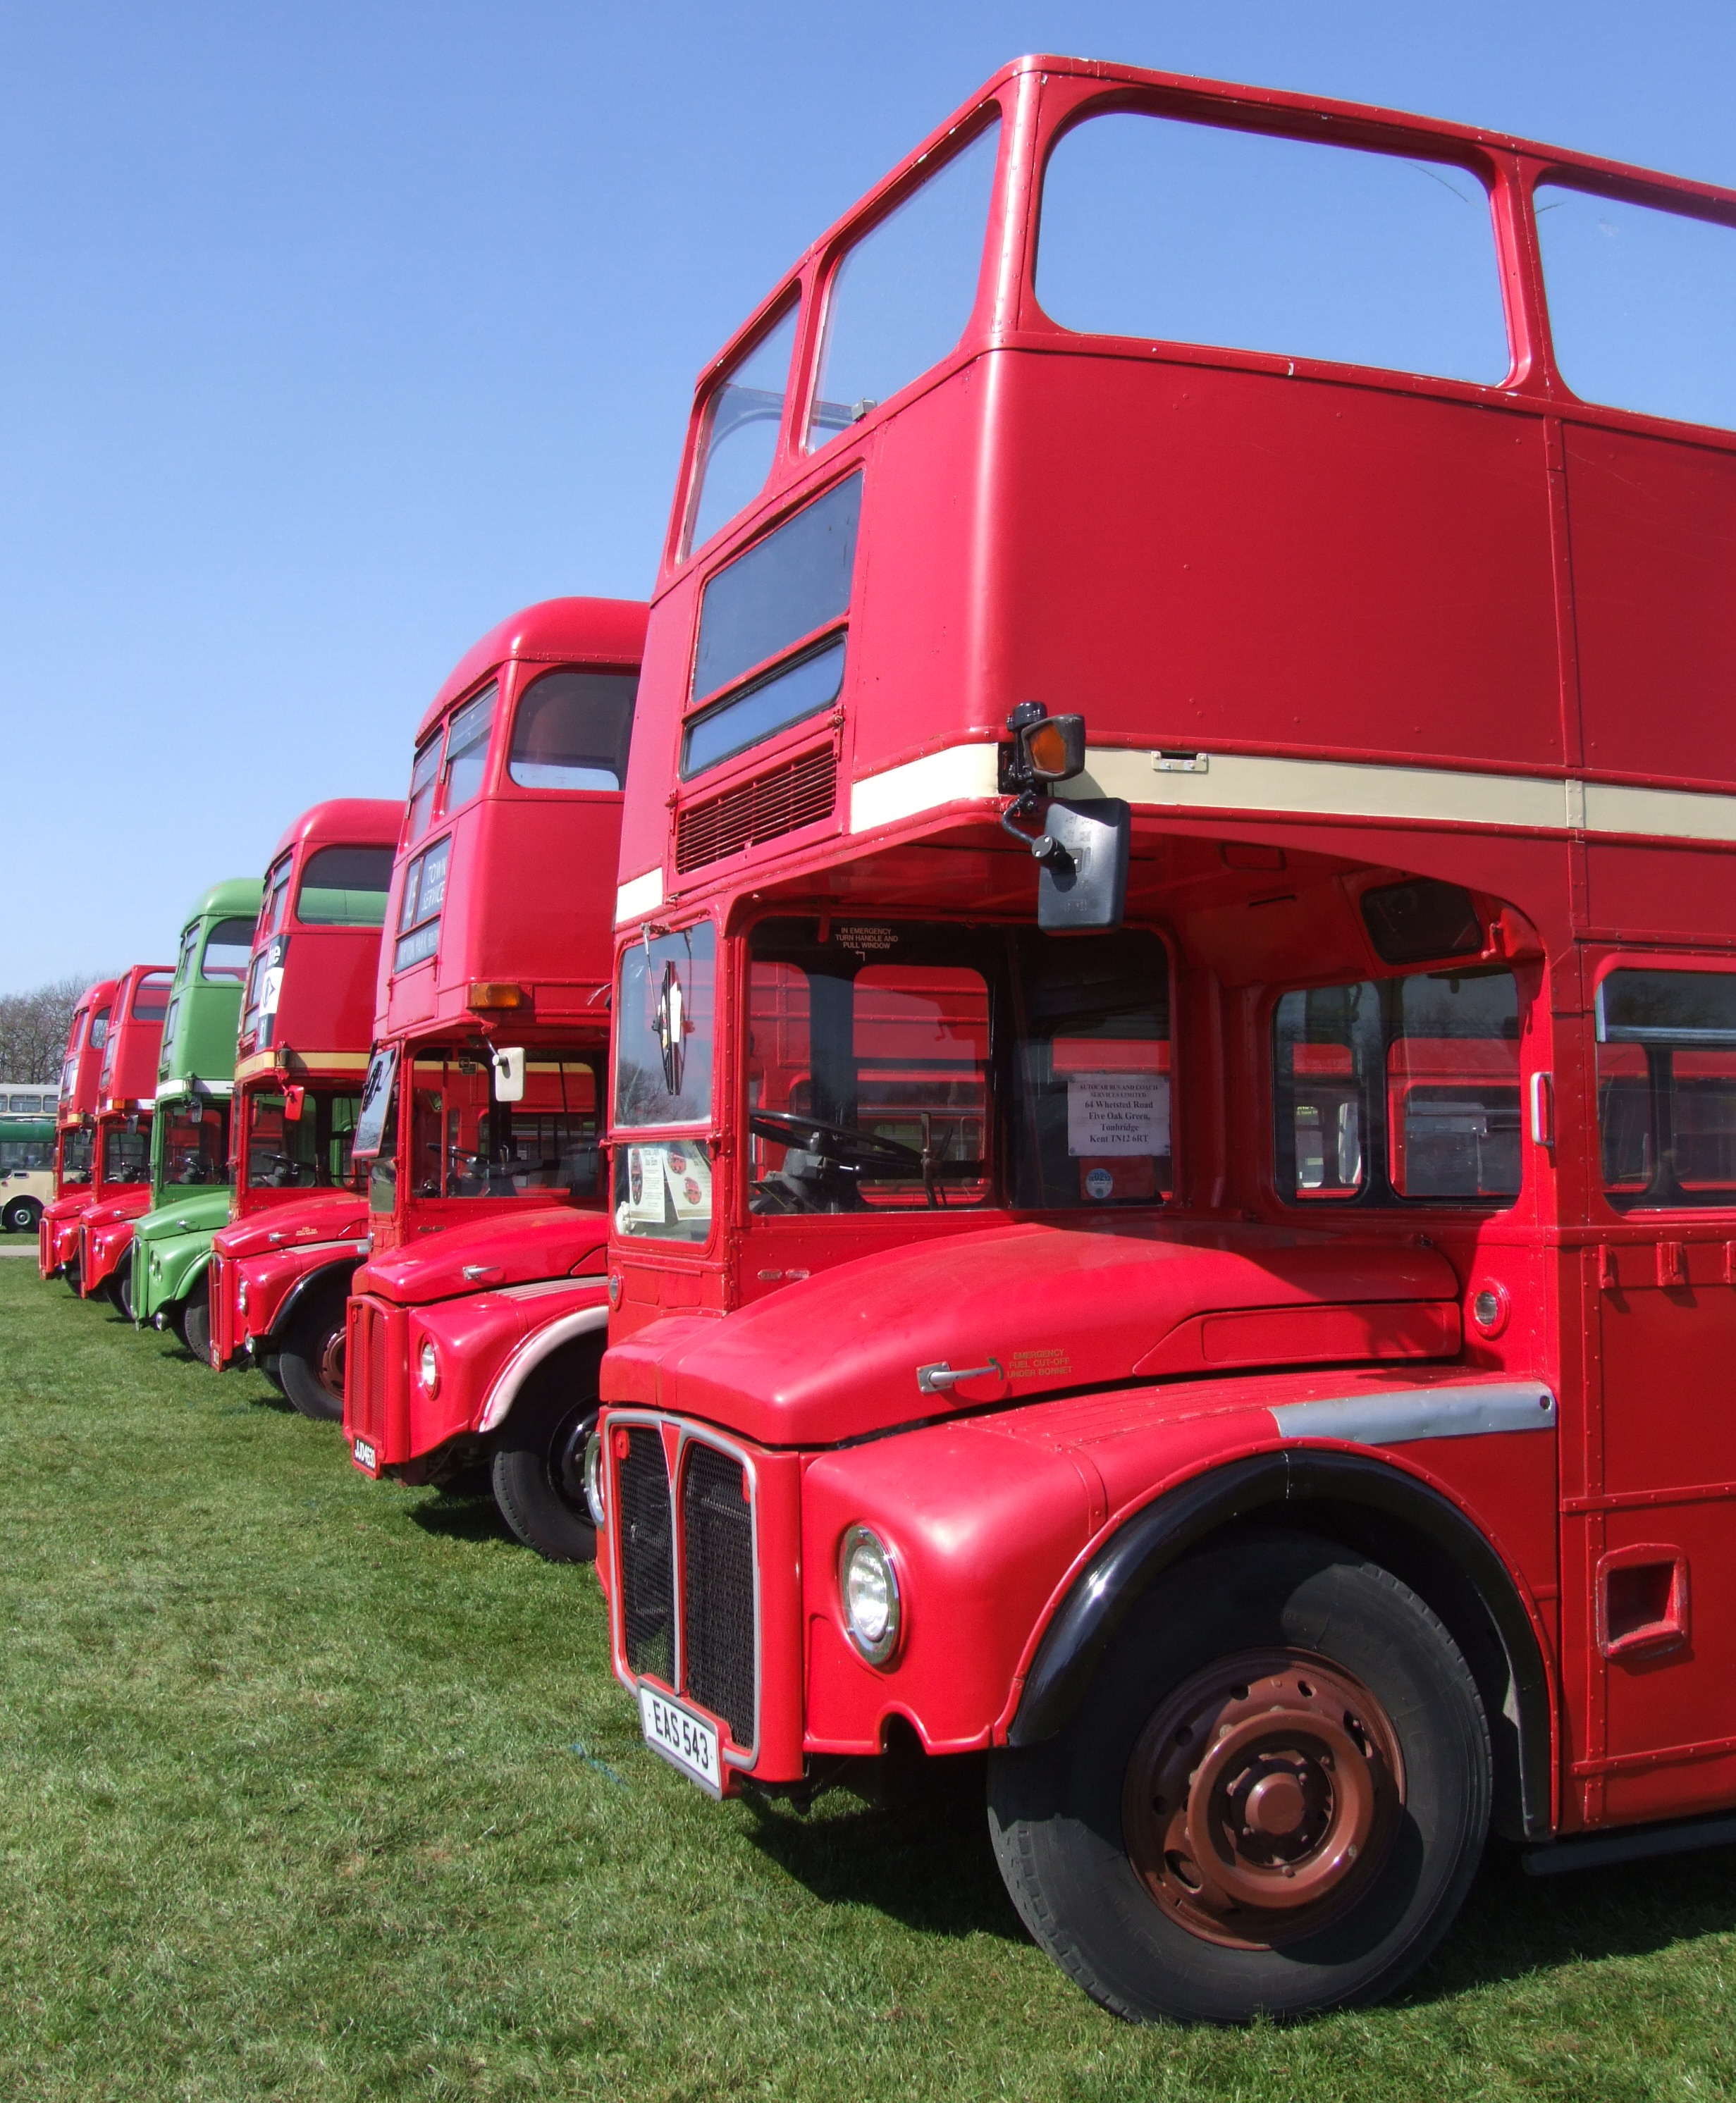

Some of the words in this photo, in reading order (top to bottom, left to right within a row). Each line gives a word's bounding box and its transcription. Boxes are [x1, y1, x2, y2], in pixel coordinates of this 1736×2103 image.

[1125, 1112, 1150, 1121] Green,
[1100, 1123, 1139, 1132] Tonbridge
[1014, 1348, 1064, 1359] EMERGENCY
[1009, 1360, 1030, 1369] FUEL
[1033, 1357, 1070, 1367] CUT-OFF
[1007, 1369, 1035, 1378] UNDER
[1038, 1366, 1073, 1376] BONNET
[653, 1699, 679, 1748] EAS
[683, 1720, 709, 1770] 543
